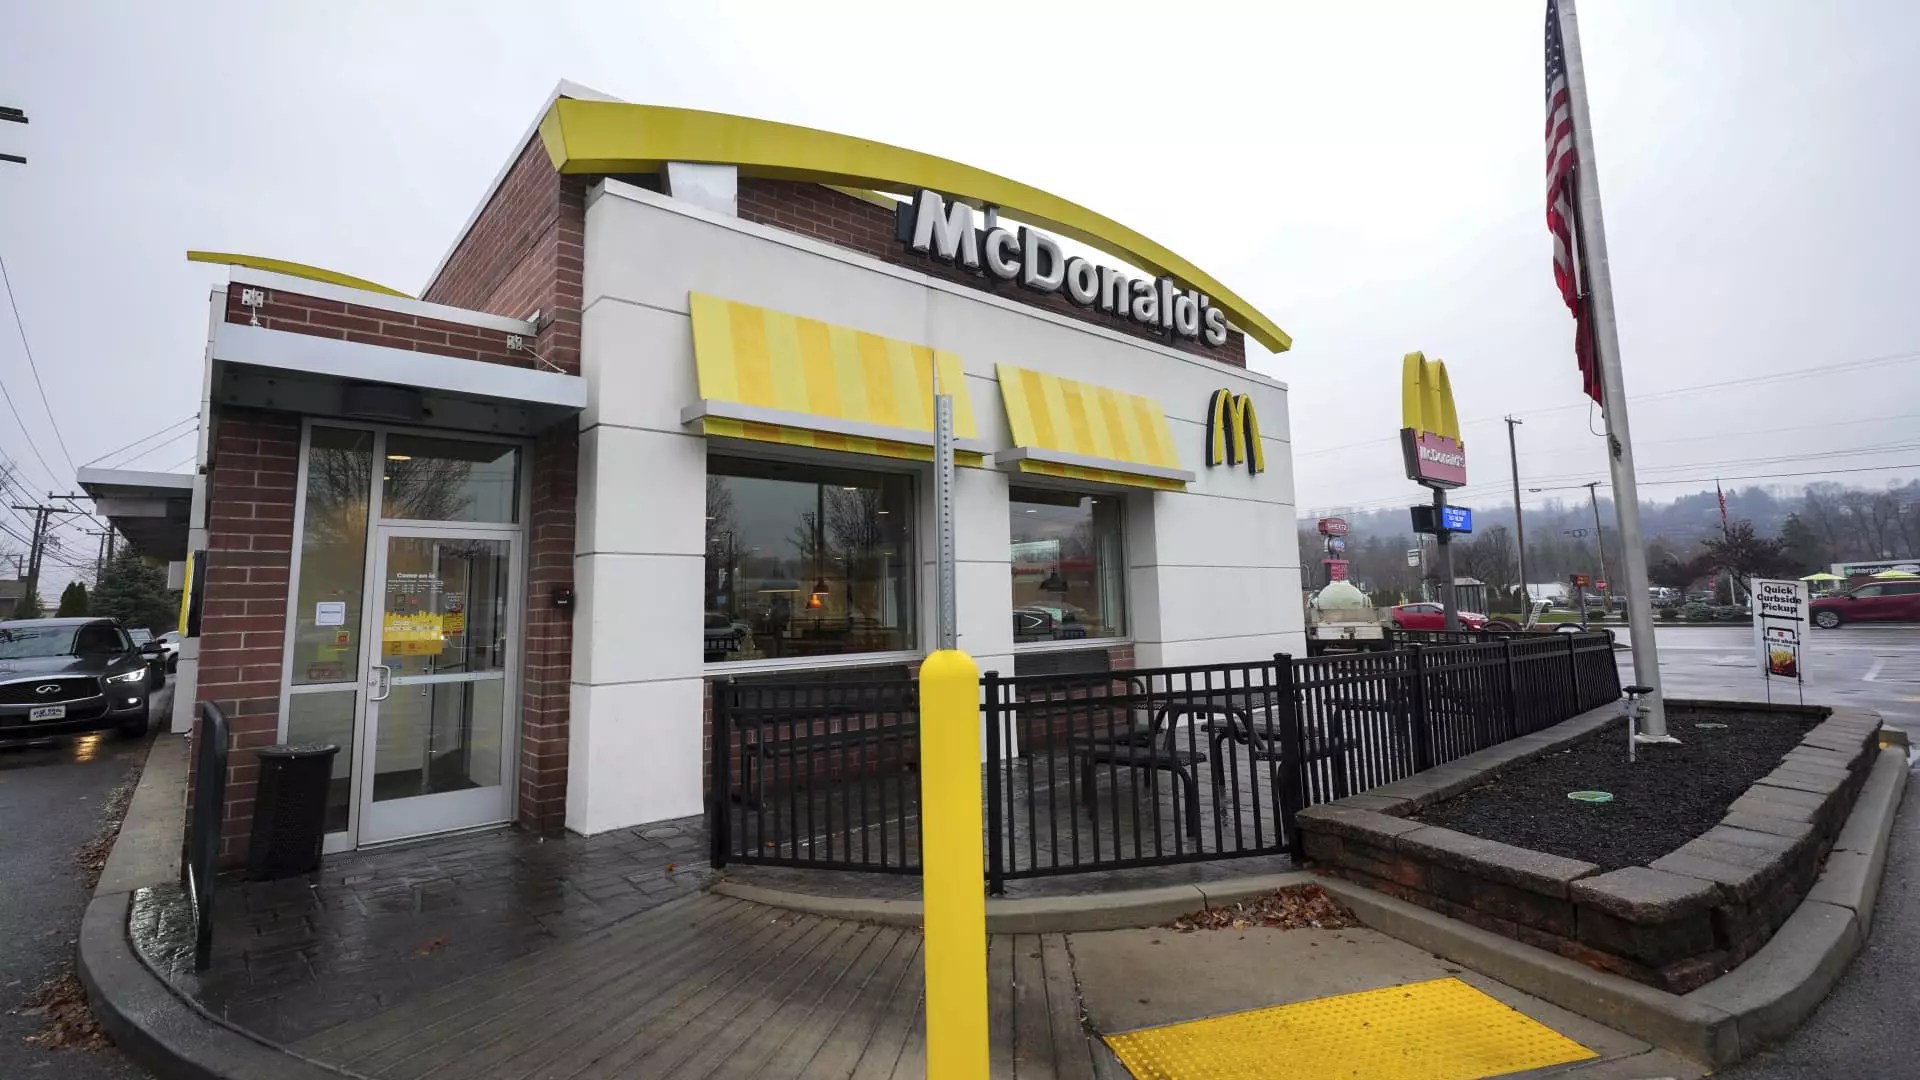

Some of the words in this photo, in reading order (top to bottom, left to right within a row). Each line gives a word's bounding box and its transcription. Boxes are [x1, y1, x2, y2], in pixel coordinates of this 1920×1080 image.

[913, 189, 1227, 347] McDonald's
[1419, 446, 1465, 467] McDonald's
[1764, 586, 1793, 594] Quick
[1757, 594, 1802, 604] Curbside
[1763, 603, 1797, 614] Pickup
